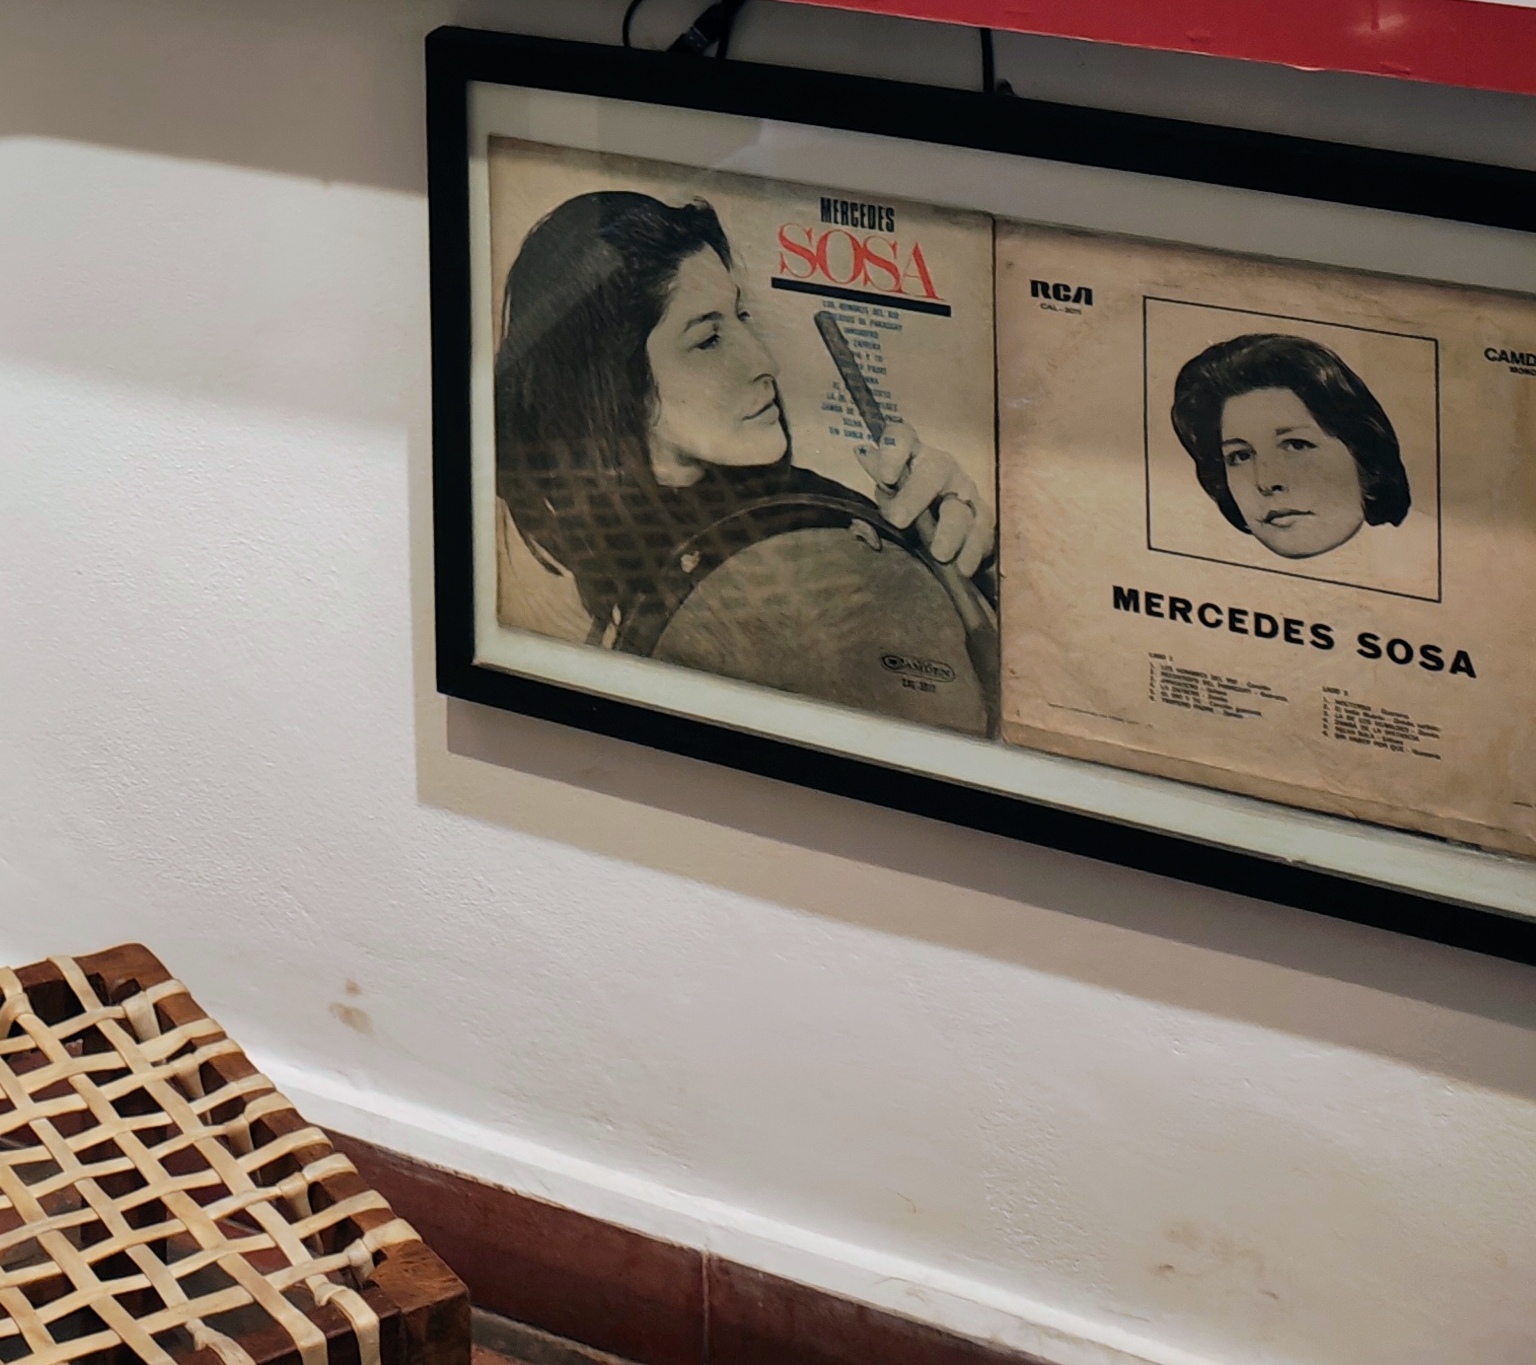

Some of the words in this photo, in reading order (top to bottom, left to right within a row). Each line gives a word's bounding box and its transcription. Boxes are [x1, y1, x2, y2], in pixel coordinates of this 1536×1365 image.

[820, 197, 895, 233] MERCEDES
[778, 222, 945, 301] SOSA
[1030, 280, 1093, 306] RCA
[1112, 585, 1335, 650] MERCEDES
[1356, 632, 1477, 679] SOSA
